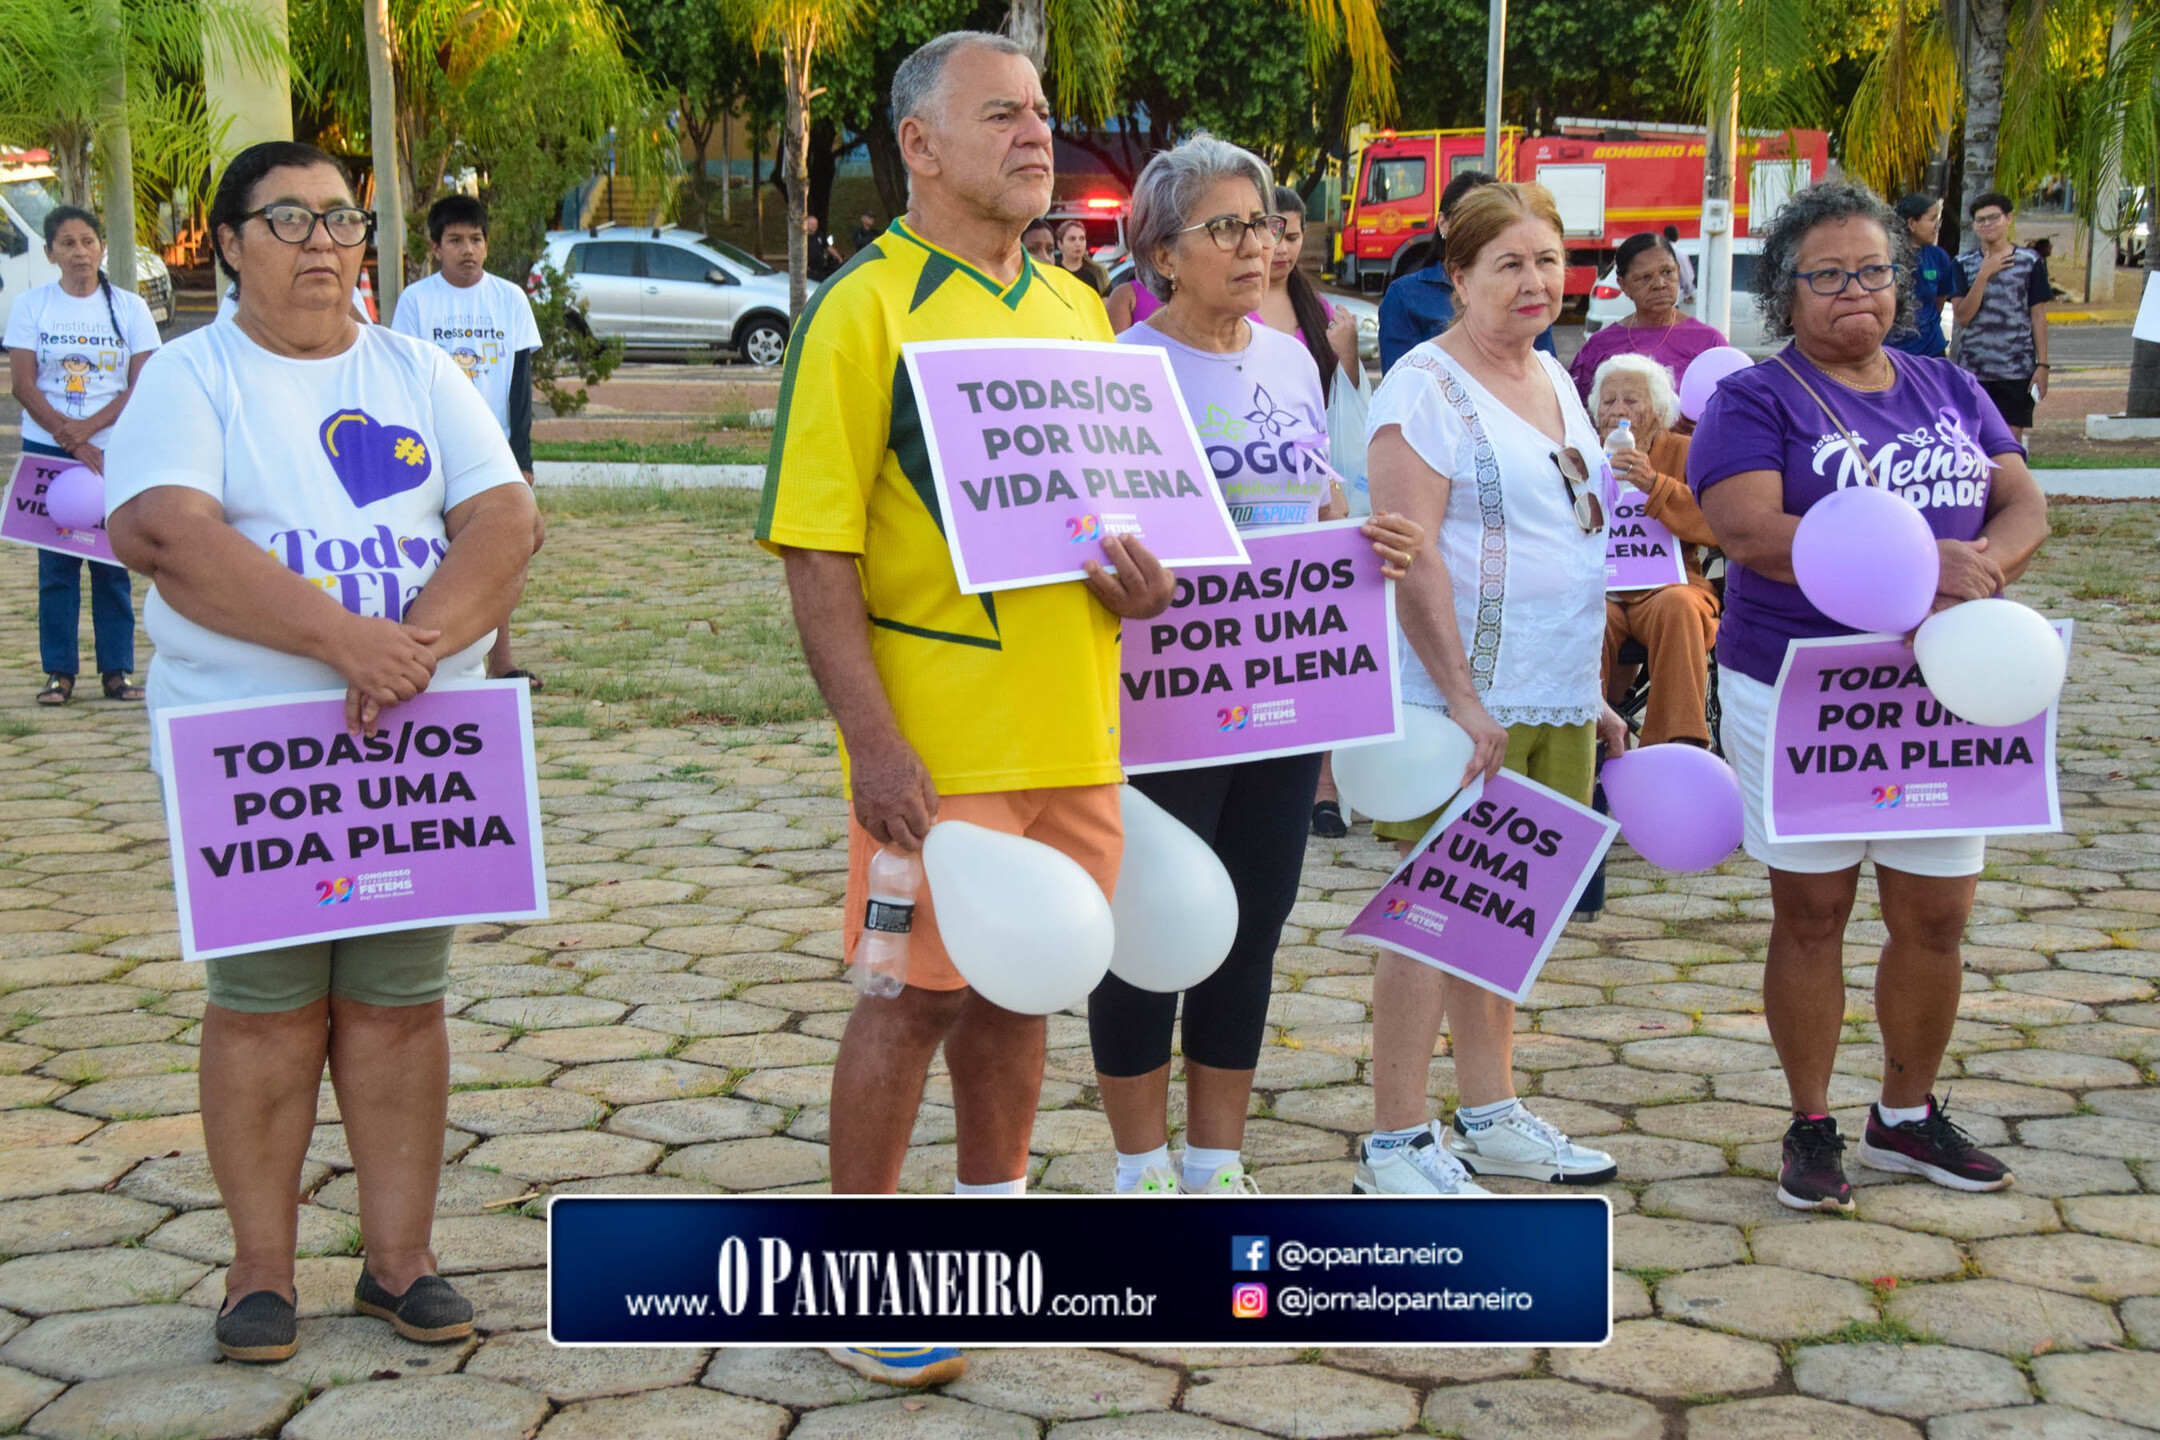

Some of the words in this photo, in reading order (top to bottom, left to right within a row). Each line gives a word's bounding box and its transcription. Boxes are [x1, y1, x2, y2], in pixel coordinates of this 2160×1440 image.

[1593, 145, 1685, 159] BOMBEIRO
[40, 332, 125, 349] Ressoarte
[52, 320, 111, 333] Instituto
[433, 328, 505, 341] Ressoarte
[957, 376, 1153, 414] TODAS/OS
[982, 424, 1073, 460] POR
[1078, 424, 1163, 455] UMA
[1812, 438, 1989, 491] Melhor
[960, 469, 1079, 511] VIDA
[1082, 468, 1202, 498] PLENA
[1227, 480, 1280, 497] Melhor
[1608, 524, 1647, 538] MA
[1169, 558, 1354, 608] ODAS/OS
[1151, 618, 1241, 654] POR
[1255, 604, 1348, 642] UMA
[1121, 663, 1233, 701] VIDA
[1245, 644, 1378, 689] PLENA
[1818, 702, 1904, 731] POR
[213, 721, 483, 778] TODAS/OS
[1786, 743, 1888, 774] VIDA
[1901, 736, 2034, 769] PLENA
[234, 783, 342, 825] POR
[358, 772, 477, 810] UMA
[200, 832, 334, 877] VIDA
[347, 816, 515, 858] PLENA
[1448, 833, 1529, 890] UMA
[360, 880, 413, 895] FETEMS
[1418, 867, 1536, 937] PLENA
